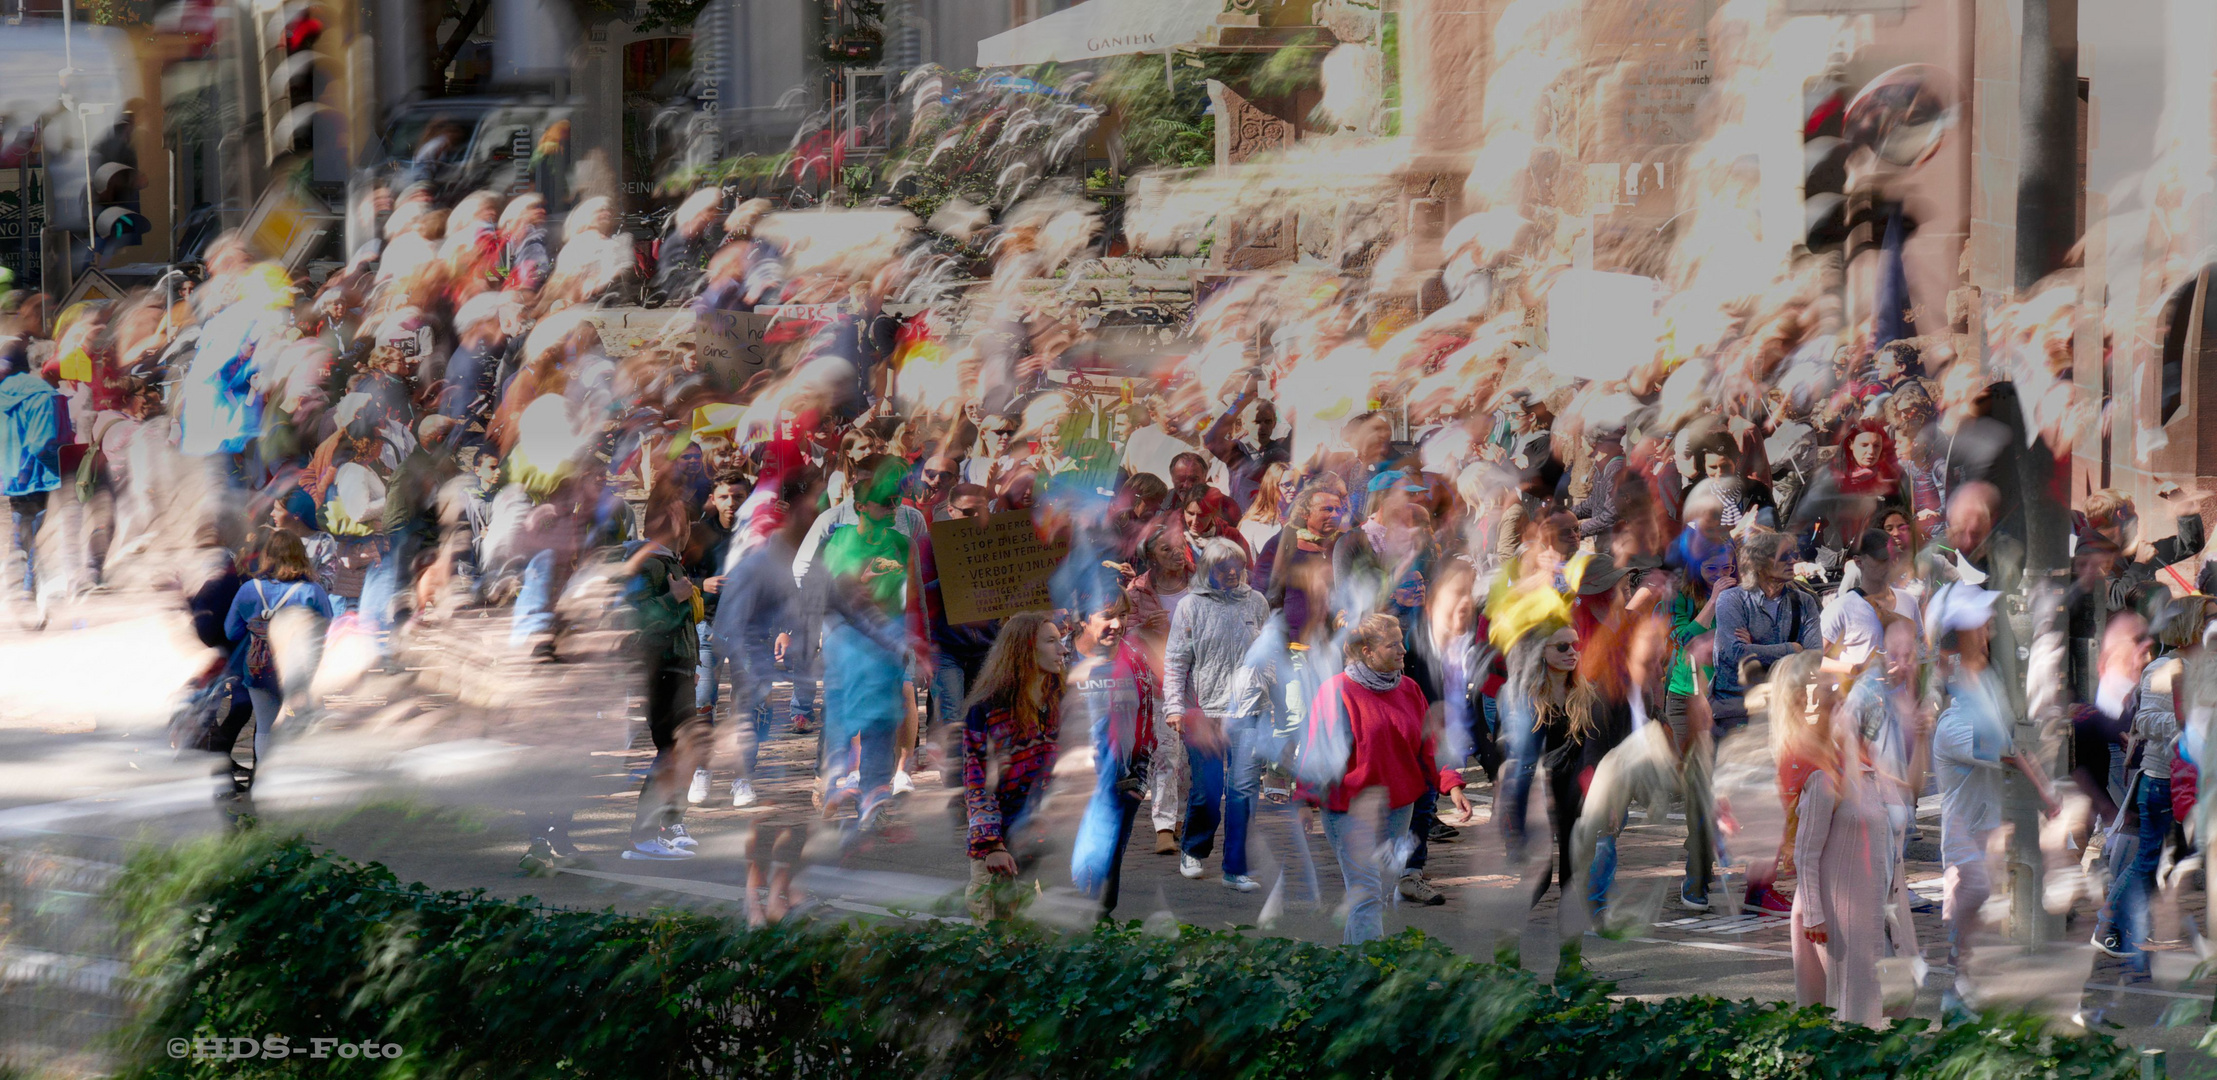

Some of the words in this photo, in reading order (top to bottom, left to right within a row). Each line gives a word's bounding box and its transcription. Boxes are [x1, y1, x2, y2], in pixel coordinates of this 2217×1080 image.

[702, 343, 731, 359] eine
[961, 526, 989, 538] STOP
[963, 539, 993, 553] STOP
[969, 564, 1014, 580] VERBOT
